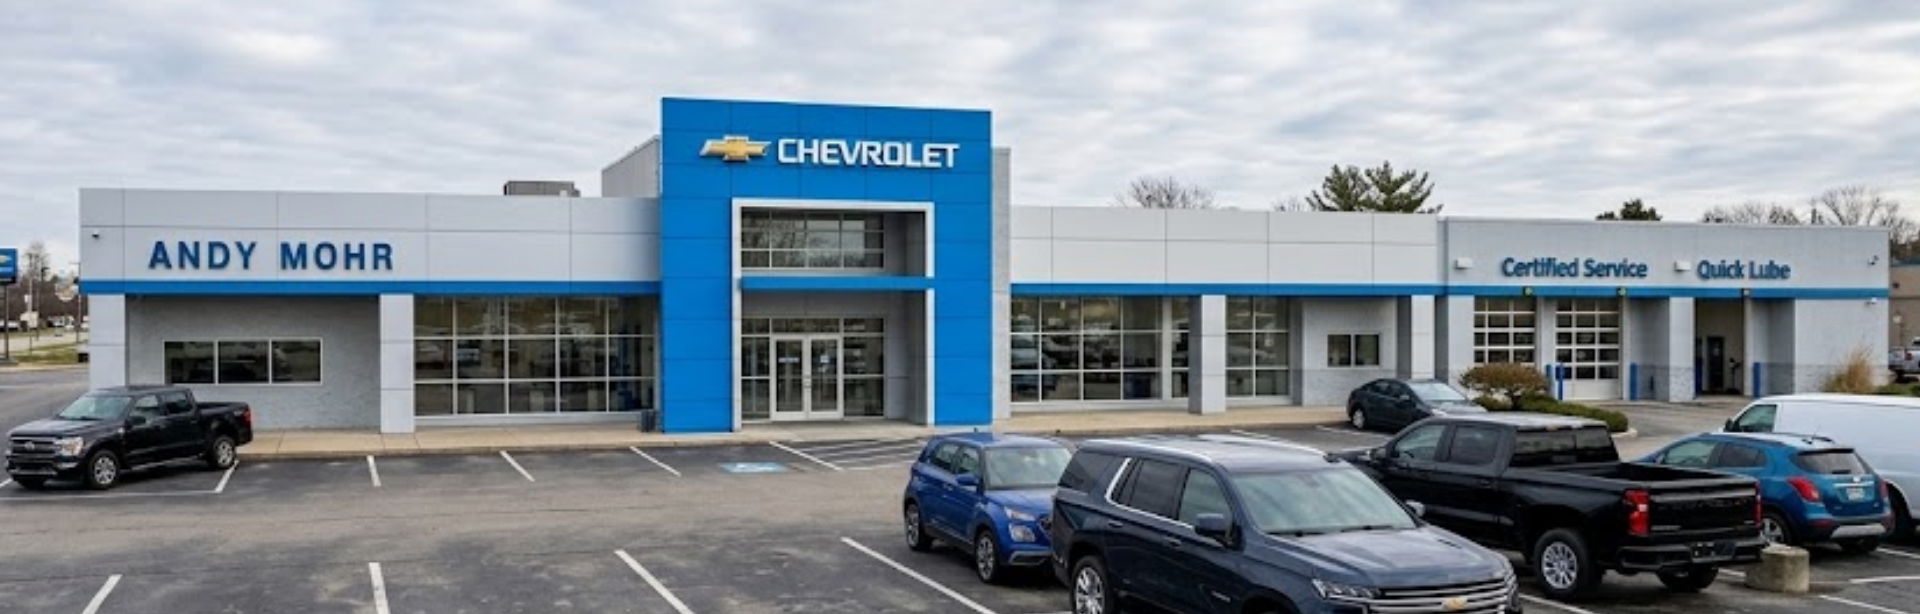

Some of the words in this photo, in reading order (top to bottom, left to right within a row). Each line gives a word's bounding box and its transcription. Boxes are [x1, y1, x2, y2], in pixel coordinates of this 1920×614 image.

[777, 138, 960, 168] CHEVROLET
[148, 240, 257, 270] ANDY
[280, 242, 393, 271] MOHR
[1501, 257, 1579, 278] Certified
[1583, 258, 1648, 278] Service
[1697, 259, 1745, 280] Quick
[1748, 260, 1791, 280] Lube
